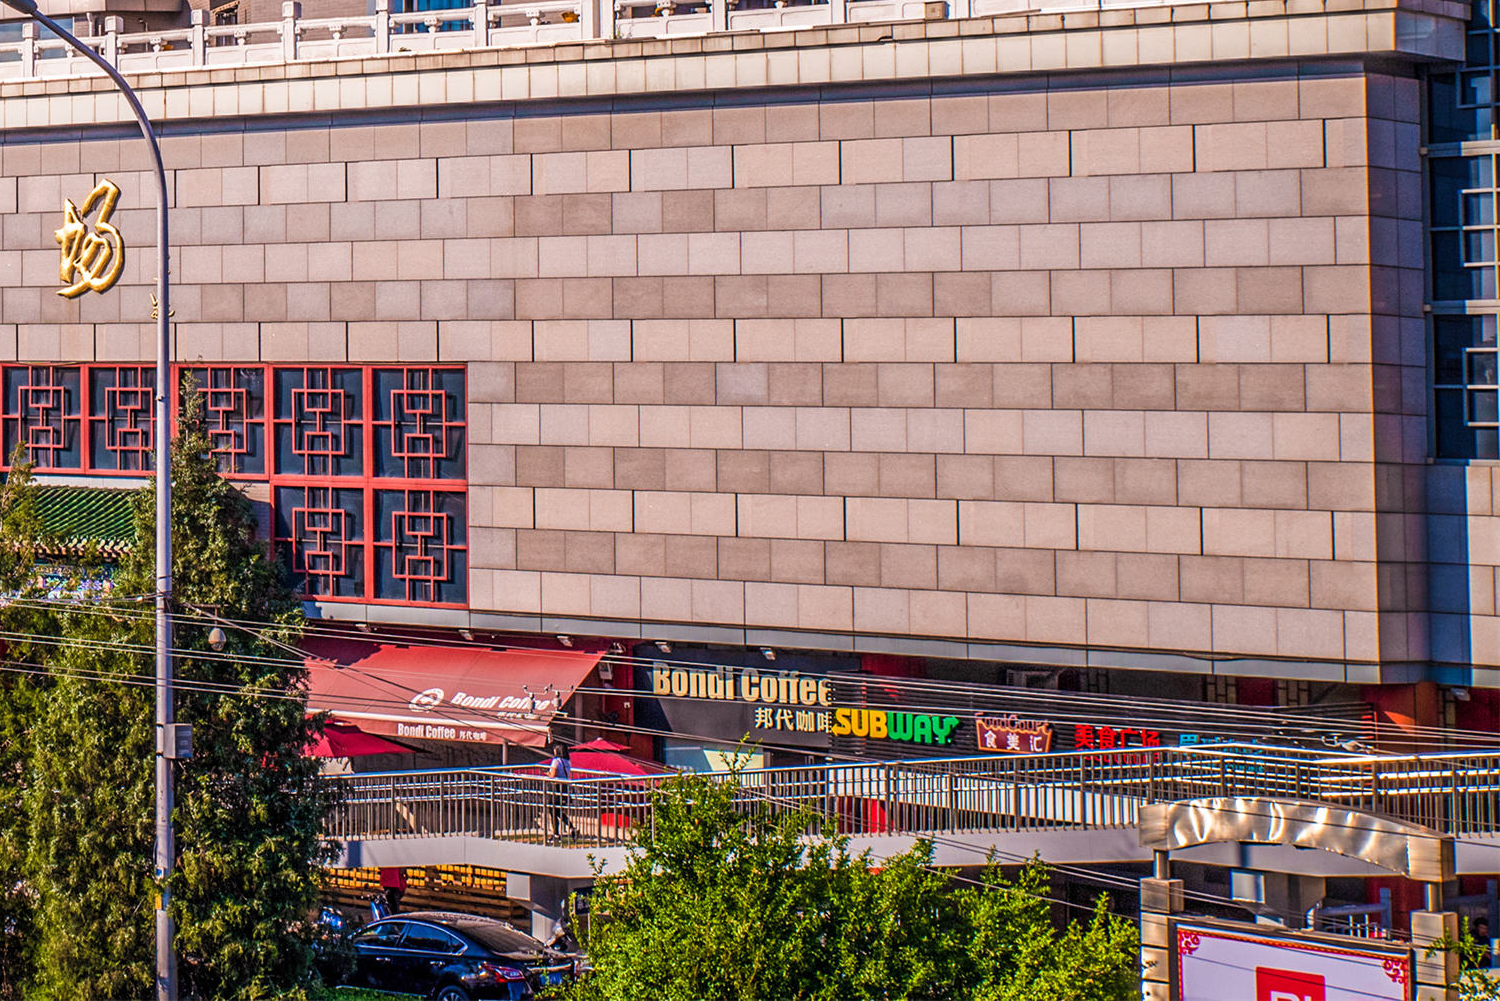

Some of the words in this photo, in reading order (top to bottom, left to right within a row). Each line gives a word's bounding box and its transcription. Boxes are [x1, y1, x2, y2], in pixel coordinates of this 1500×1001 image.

[652, 662, 735, 700] Bondi
[740, 667, 832, 707] Coffee
[450, 692, 501, 709] Bondi
[397, 722, 425, 737] Bondi
[425, 724, 456, 739] Coffee
[831, 708, 960, 744] SUBWAY
[1074, 724, 1160, 750] 美食广场
